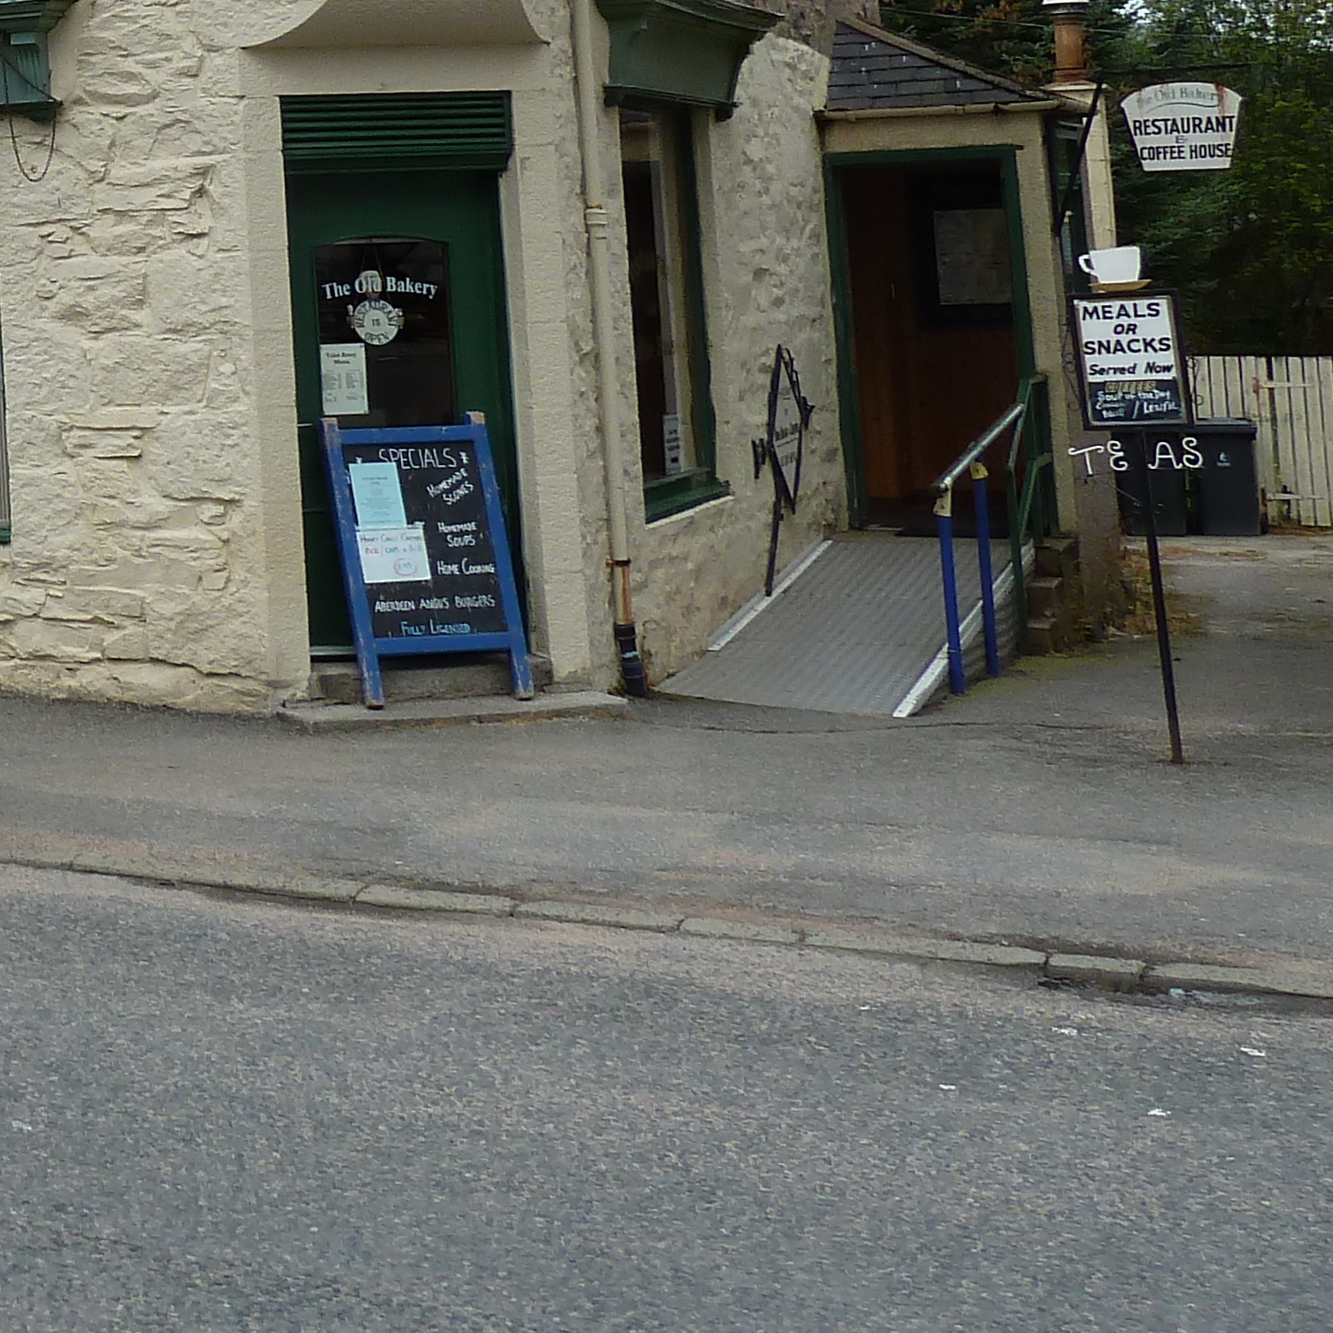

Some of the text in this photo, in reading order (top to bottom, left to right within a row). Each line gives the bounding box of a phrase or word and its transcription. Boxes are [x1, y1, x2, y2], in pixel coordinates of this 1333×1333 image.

[1133, 115, 1236, 136] RESTAURANT
[1139, 142, 1234, 161] COFFEE HOUSE
[321, 274, 438, 300] The Old Bakery
[1082, 302, 1161, 321] MEALS
[1113, 323, 1138, 335] OR
[1083, 337, 1172, 355] SNACKS
[1088, 361, 1174, 376] Served Now
[378, 448, 458, 470] SPECIALS
